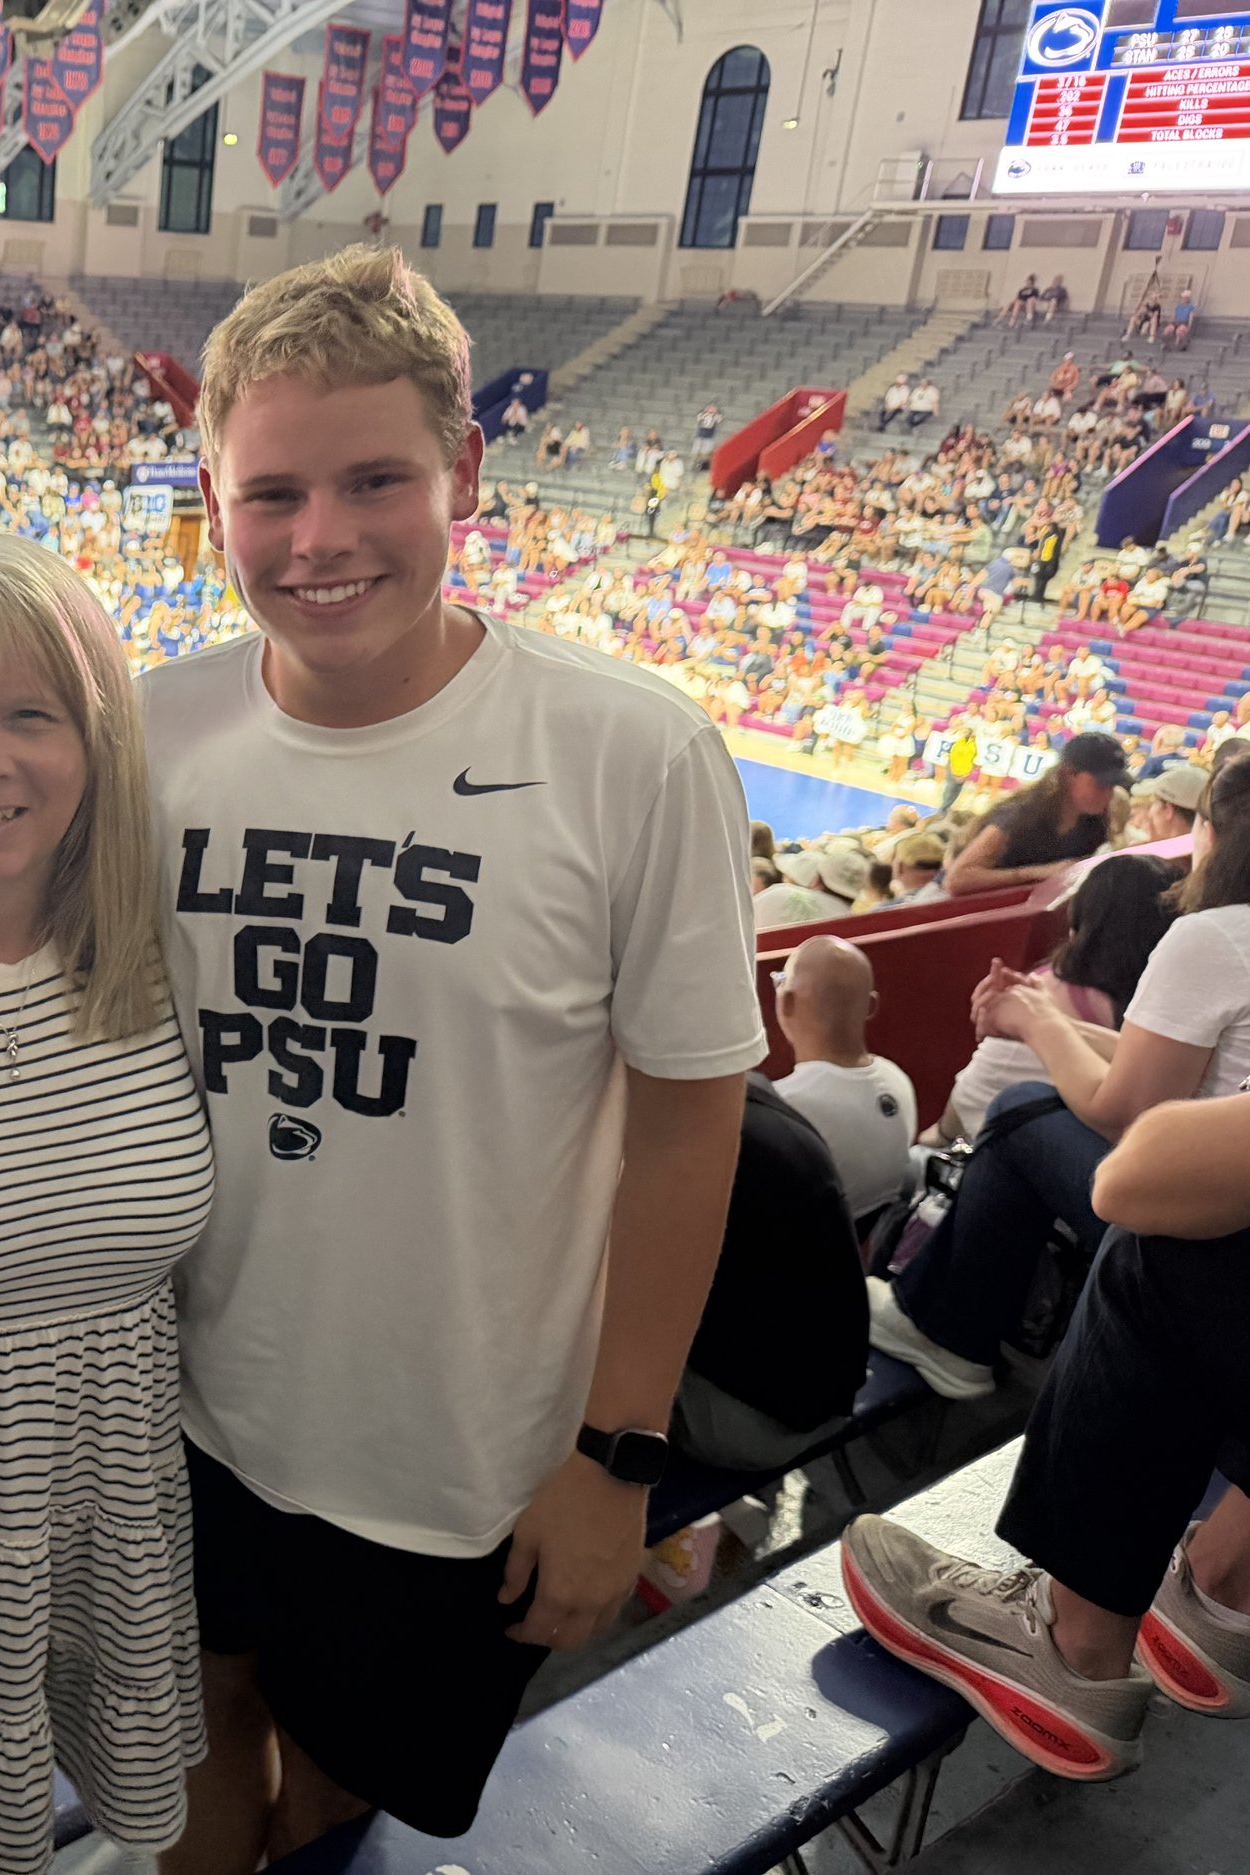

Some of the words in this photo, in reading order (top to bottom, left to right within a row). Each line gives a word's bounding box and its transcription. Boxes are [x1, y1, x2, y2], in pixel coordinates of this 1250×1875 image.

[1130, 32, 1159, 48] PSU
[1163, 69, 1191, 81] ACES
[1198, 65, 1240, 80] ERRORS
[1145, 84, 1186, 97] HITTING
[1179, 98, 1209, 110] KILLS
[1177, 113, 1203, 126] DIGS
[1151, 129, 1180, 142] TOTAL
[1181, 127, 1224, 140] BLOCKS
[984, 743, 1002, 764] S
[1023, 754, 1044, 775] U
[176, 827, 483, 945] LET'S
[234, 924, 378, 1024] GO
[198, 1008, 418, 1118] PSU
